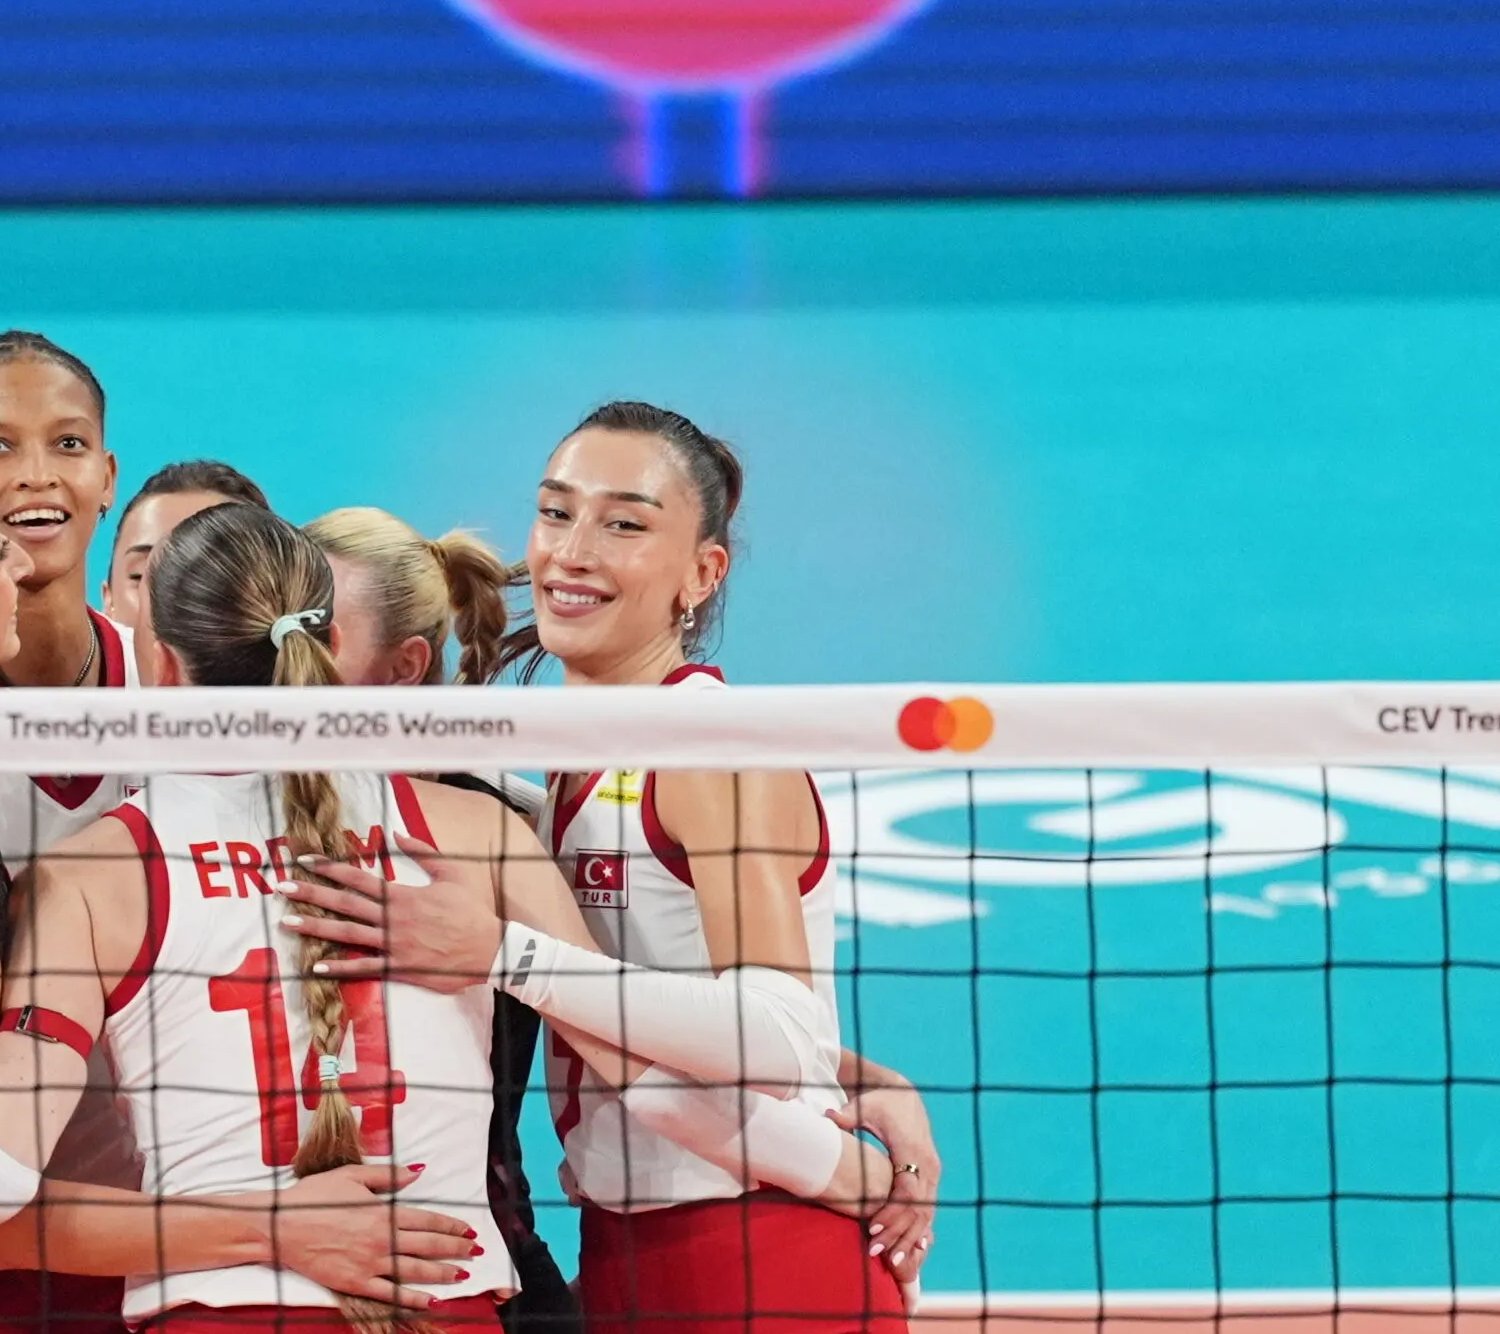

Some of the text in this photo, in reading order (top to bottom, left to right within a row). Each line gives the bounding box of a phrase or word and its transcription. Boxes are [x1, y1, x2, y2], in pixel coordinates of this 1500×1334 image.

[8, 713, 136, 744] Trendyol
[148, 712, 305, 744] EuroVolley
[317, 713, 388, 737] 2026
[399, 713, 514, 737] Women
[1379, 707, 1441, 732] CEV
[188, 824, 396, 899] ERM
[581, 890, 612, 904] TUR
[208, 947, 407, 1167] 14
